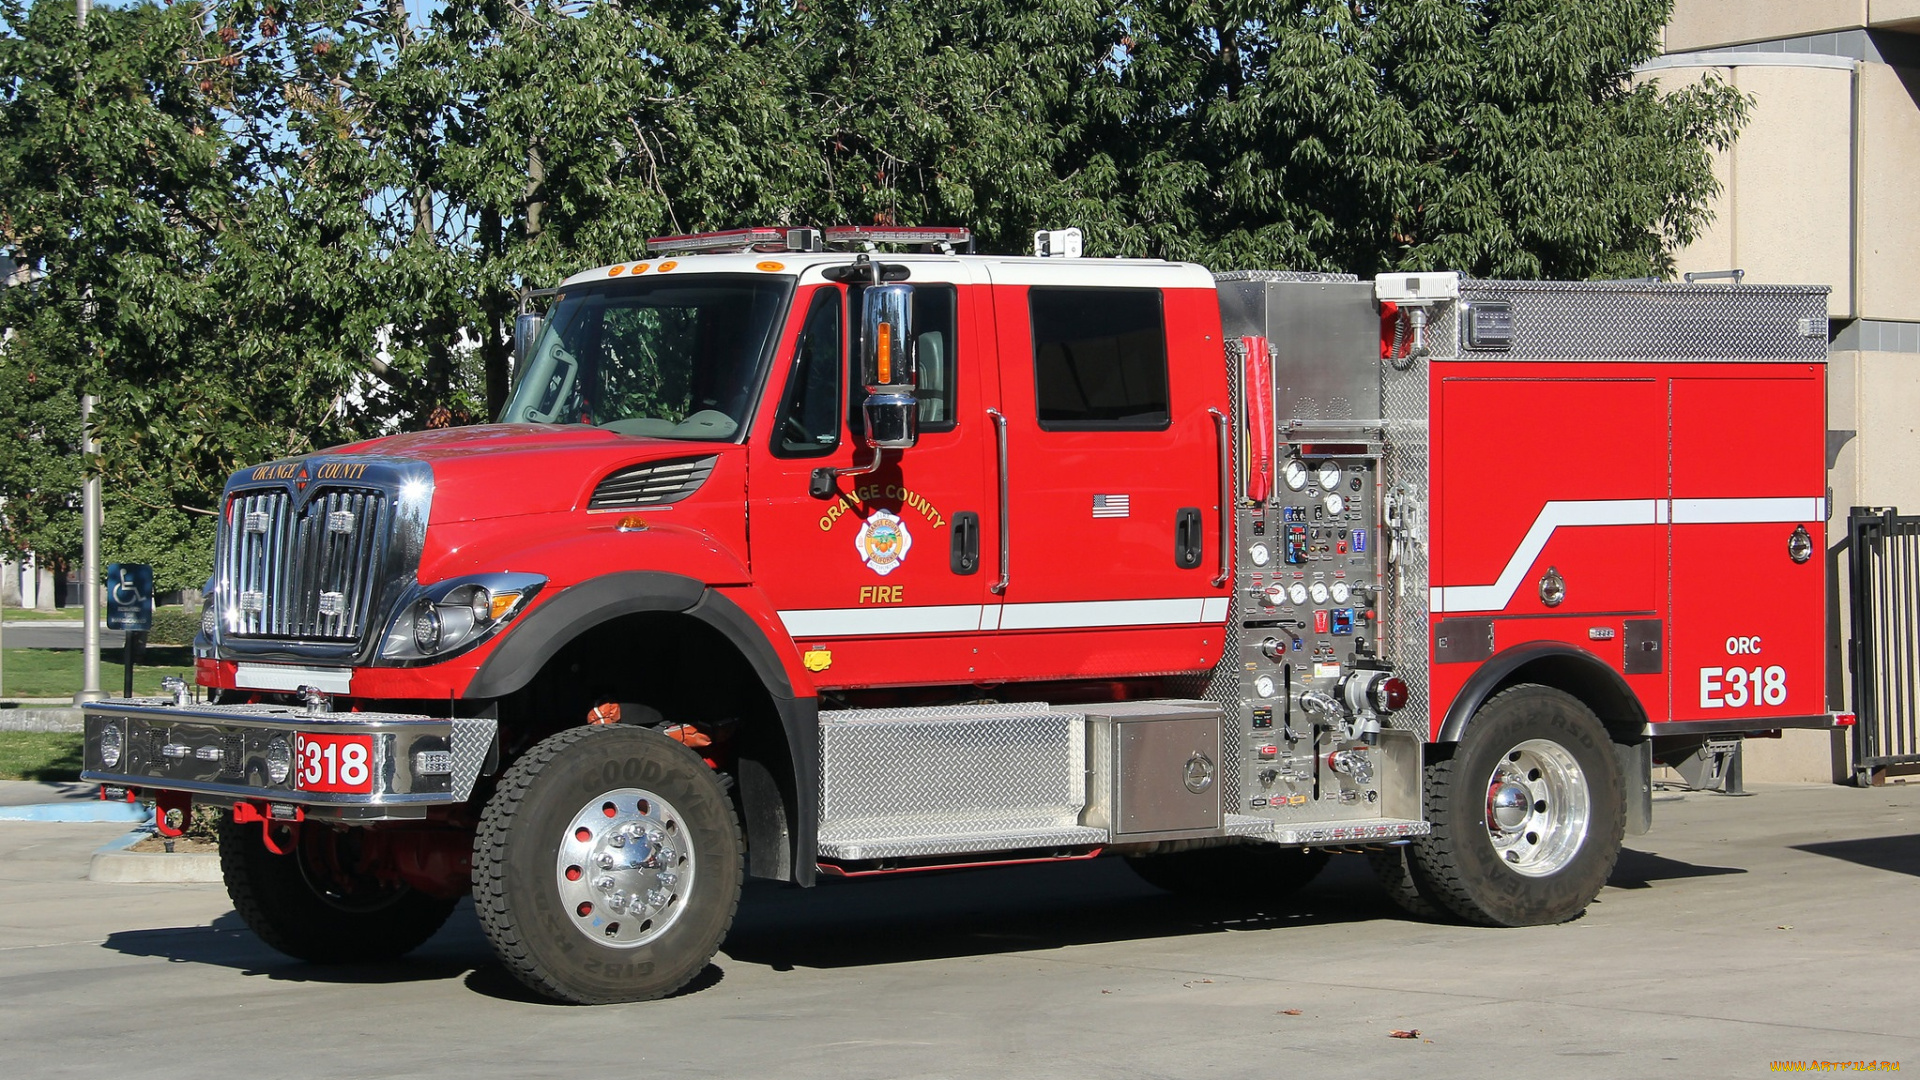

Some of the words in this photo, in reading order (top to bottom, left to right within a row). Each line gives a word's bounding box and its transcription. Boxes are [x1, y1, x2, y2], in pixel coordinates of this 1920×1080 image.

[252, 463, 300, 481] ORANGE
[317, 463, 370, 479] COUNTY
[819, 484, 880, 531] ORANGE
[885, 484, 946, 529] COUNTY
[859, 585, 904, 603] FIRE
[1725, 636, 1761, 655] ORC
[1700, 665, 1787, 708] E318
[297, 735, 305, 787] ORC
[305, 741, 369, 786] 318
